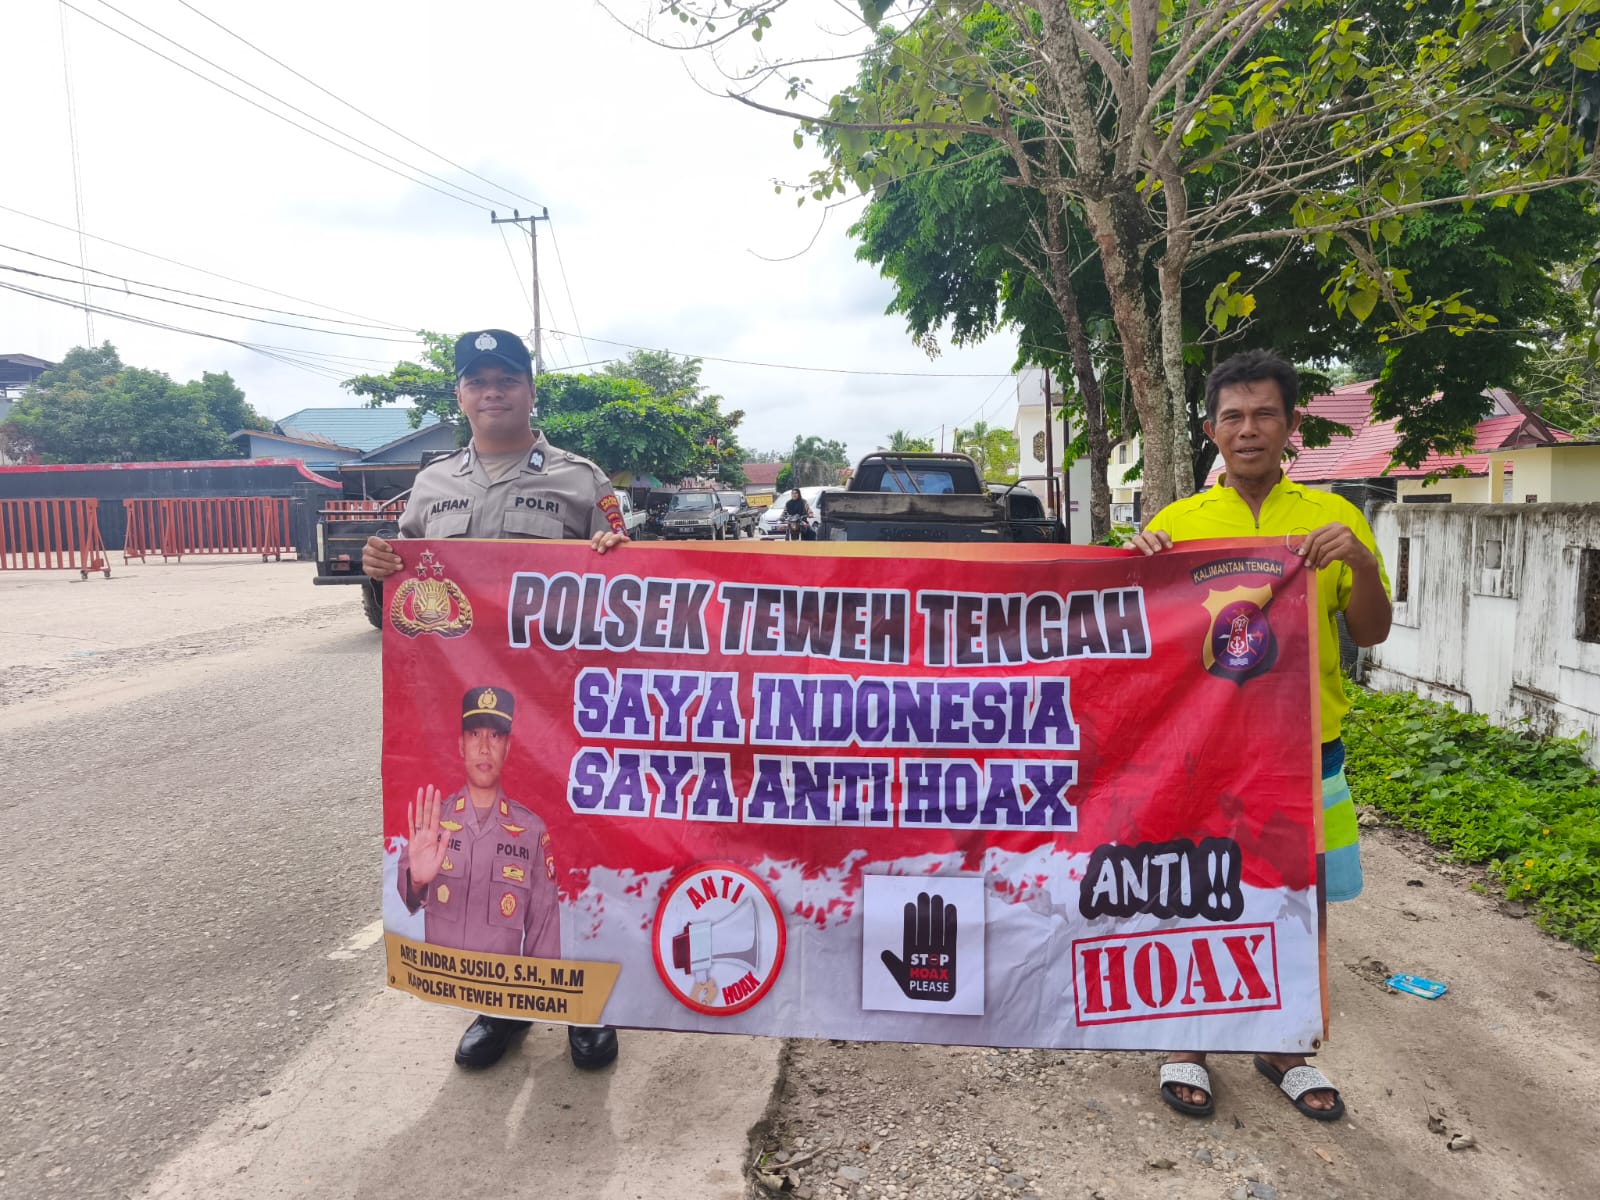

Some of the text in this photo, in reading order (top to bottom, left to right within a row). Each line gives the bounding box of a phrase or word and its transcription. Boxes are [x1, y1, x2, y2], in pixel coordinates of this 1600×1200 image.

[430, 498, 469, 515] ALFIAN
[514, 496, 560, 514] POLRI
[1193, 561, 1282, 582] KALIMANTAN TENGAH
[508, 572, 1152, 667] POLSEK TEWEH TENGAH
[573, 667, 1081, 751] SAYA INDONESIA
[566, 746, 1079, 832] SAYA ANTI HOAX
[496, 843, 530, 860] POLRI
[686, 875, 745, 910] ANTI
[1090, 850, 1233, 910] ANTI !!
[400, 943, 585, 987] ARIE INDRA SUSILO, S.H., M.M
[909, 967, 949, 980] HOAX
[1080, 934, 1273, 1014] HOAX
[407, 971, 568, 1014] KAPOLSEK TEWEH TENGAH
[721, 970, 761, 1006] HOAX
[909, 981, 950, 994] PLEASE
